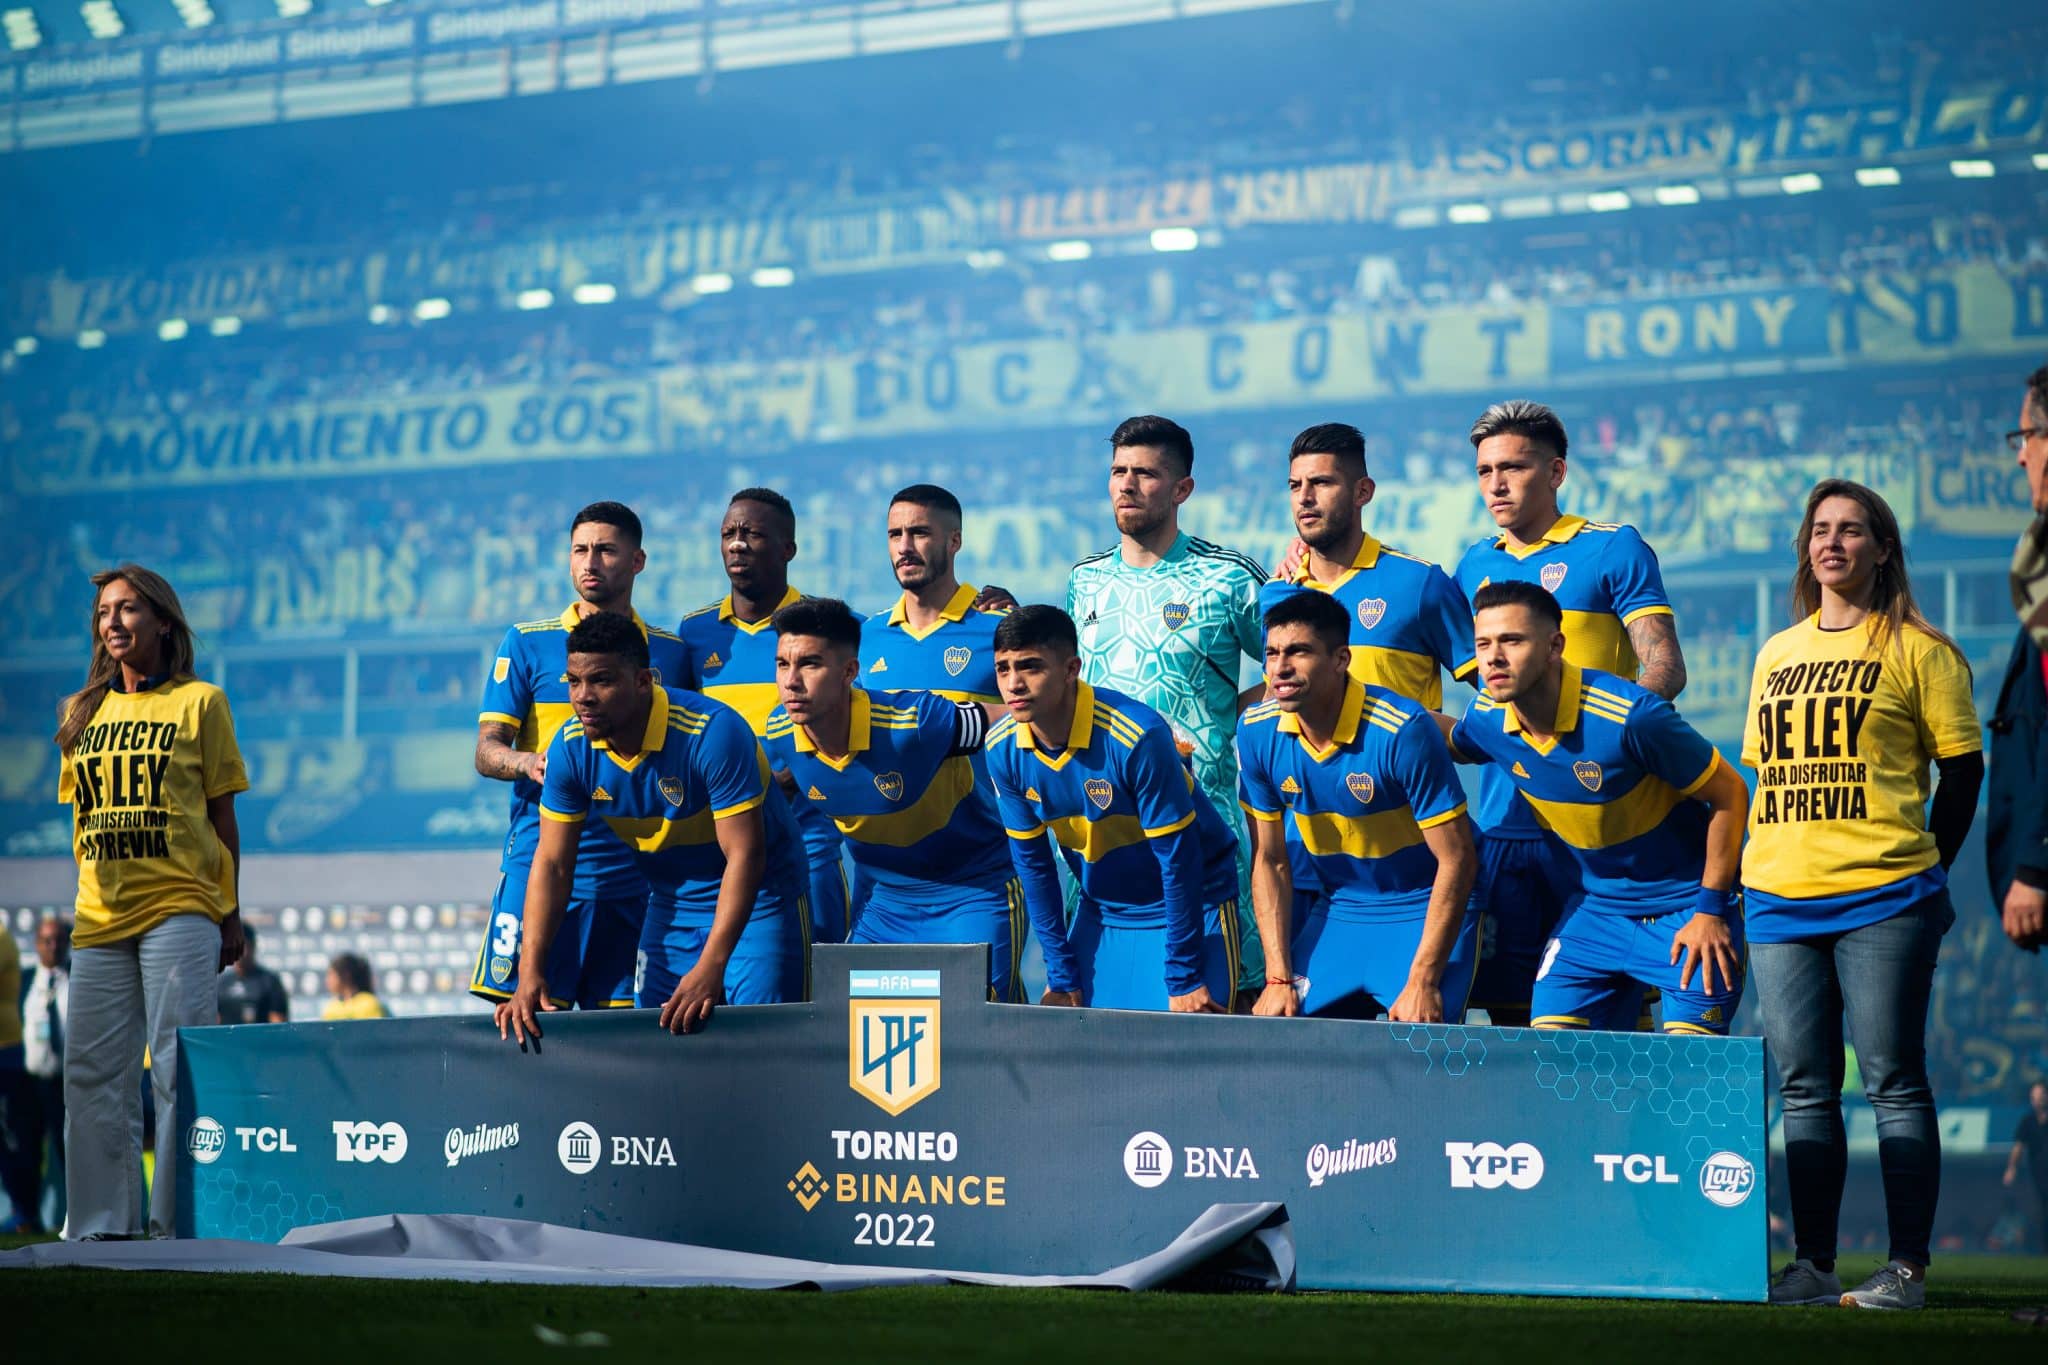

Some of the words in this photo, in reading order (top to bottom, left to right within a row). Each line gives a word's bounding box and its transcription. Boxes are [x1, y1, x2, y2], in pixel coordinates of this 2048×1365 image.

[1585, 295, 1797, 360] RONY
[90, 402, 488, 477] MOVIMIENTO
[1761, 659, 1882, 702] PROYECTO
[1758, 699, 1794, 764] DE
[1804, 696, 1873, 759] LEY
[111, 754, 171, 807] LEY
[1759, 766, 1787, 789] ARA
[1790, 762, 1867, 786] DISFRUTAR
[1757, 790, 1779, 825] LA
[1783, 786, 1868, 823] PREVIA
[96, 830, 170, 861] PREVIA
[492, 911, 523, 957] 3
[880, 976, 910, 990] AFA
[235, 1127, 297, 1152] TCL
[345, 1133, 397, 1150] YPF
[444, 1122, 520, 1168] Quilmes
[610, 1136, 677, 1167] BNA
[831, 1130, 958, 1162] TORNEO
[1184, 1146, 1259, 1179] BNA
[1306, 1137, 1397, 1188] Quilmes
[1462, 1156, 1529, 1175] YPF
[1594, 1154, 1679, 1184] TCL
[836, 1173, 1007, 1206] BINANCE
[854, 1212, 936, 1247] 2022
